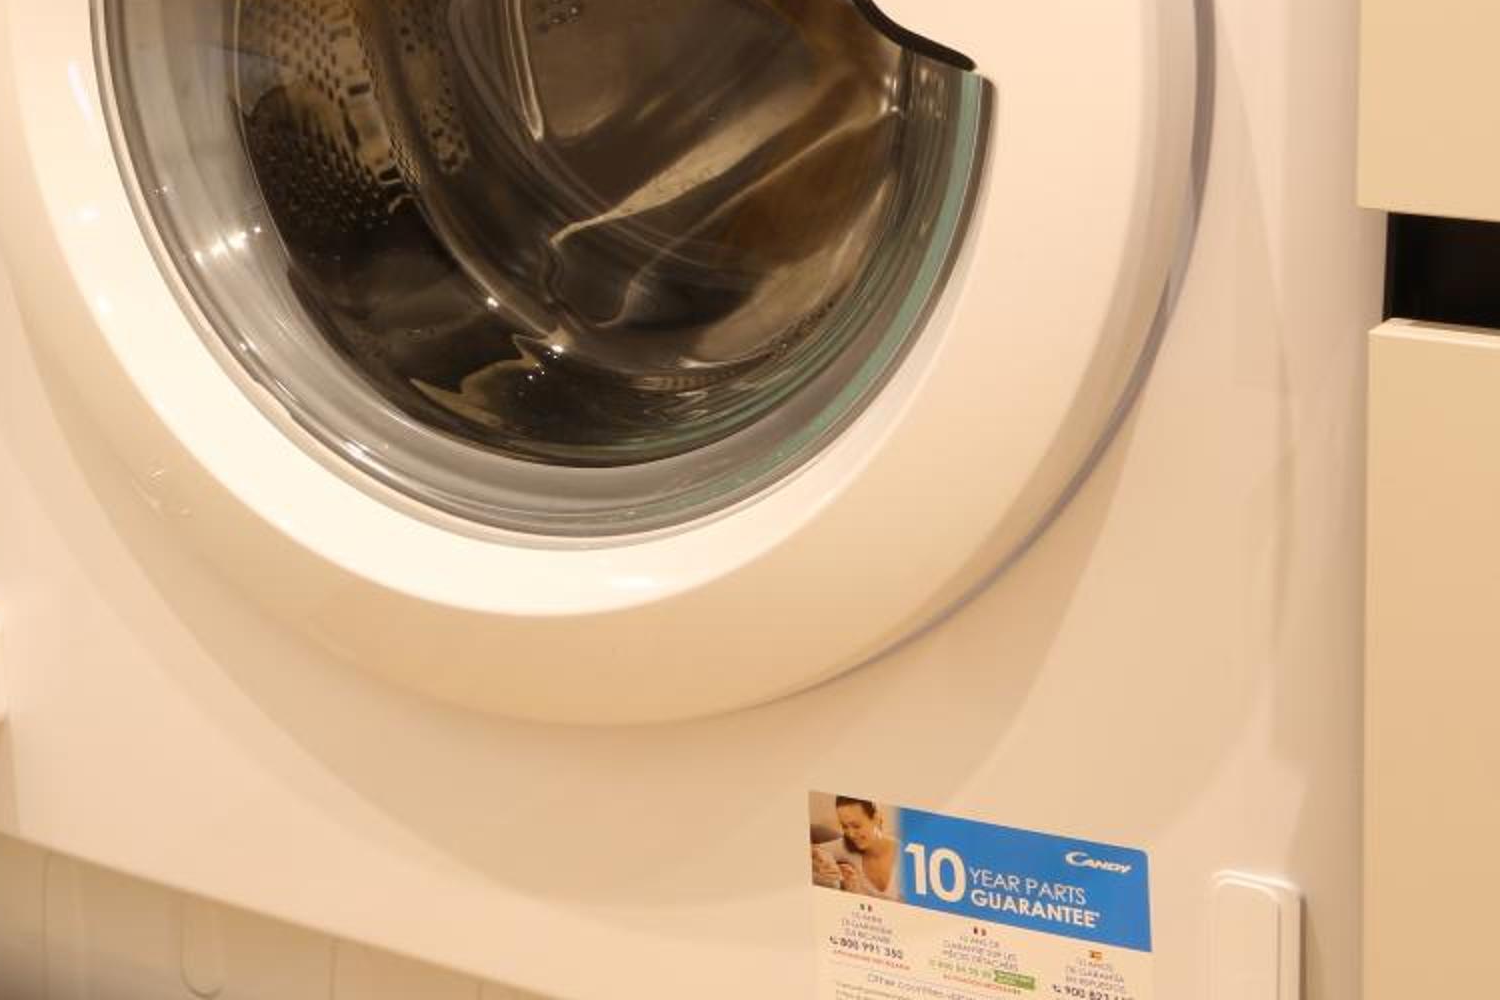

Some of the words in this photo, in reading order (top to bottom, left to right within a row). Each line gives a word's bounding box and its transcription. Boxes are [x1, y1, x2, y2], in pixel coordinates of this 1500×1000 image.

[904, 842, 966, 903] 10
[968, 866, 1021, 893] YEAR
[1025, 877, 1087, 906] PARTS
[1065, 851, 1132, 873] CANDY
